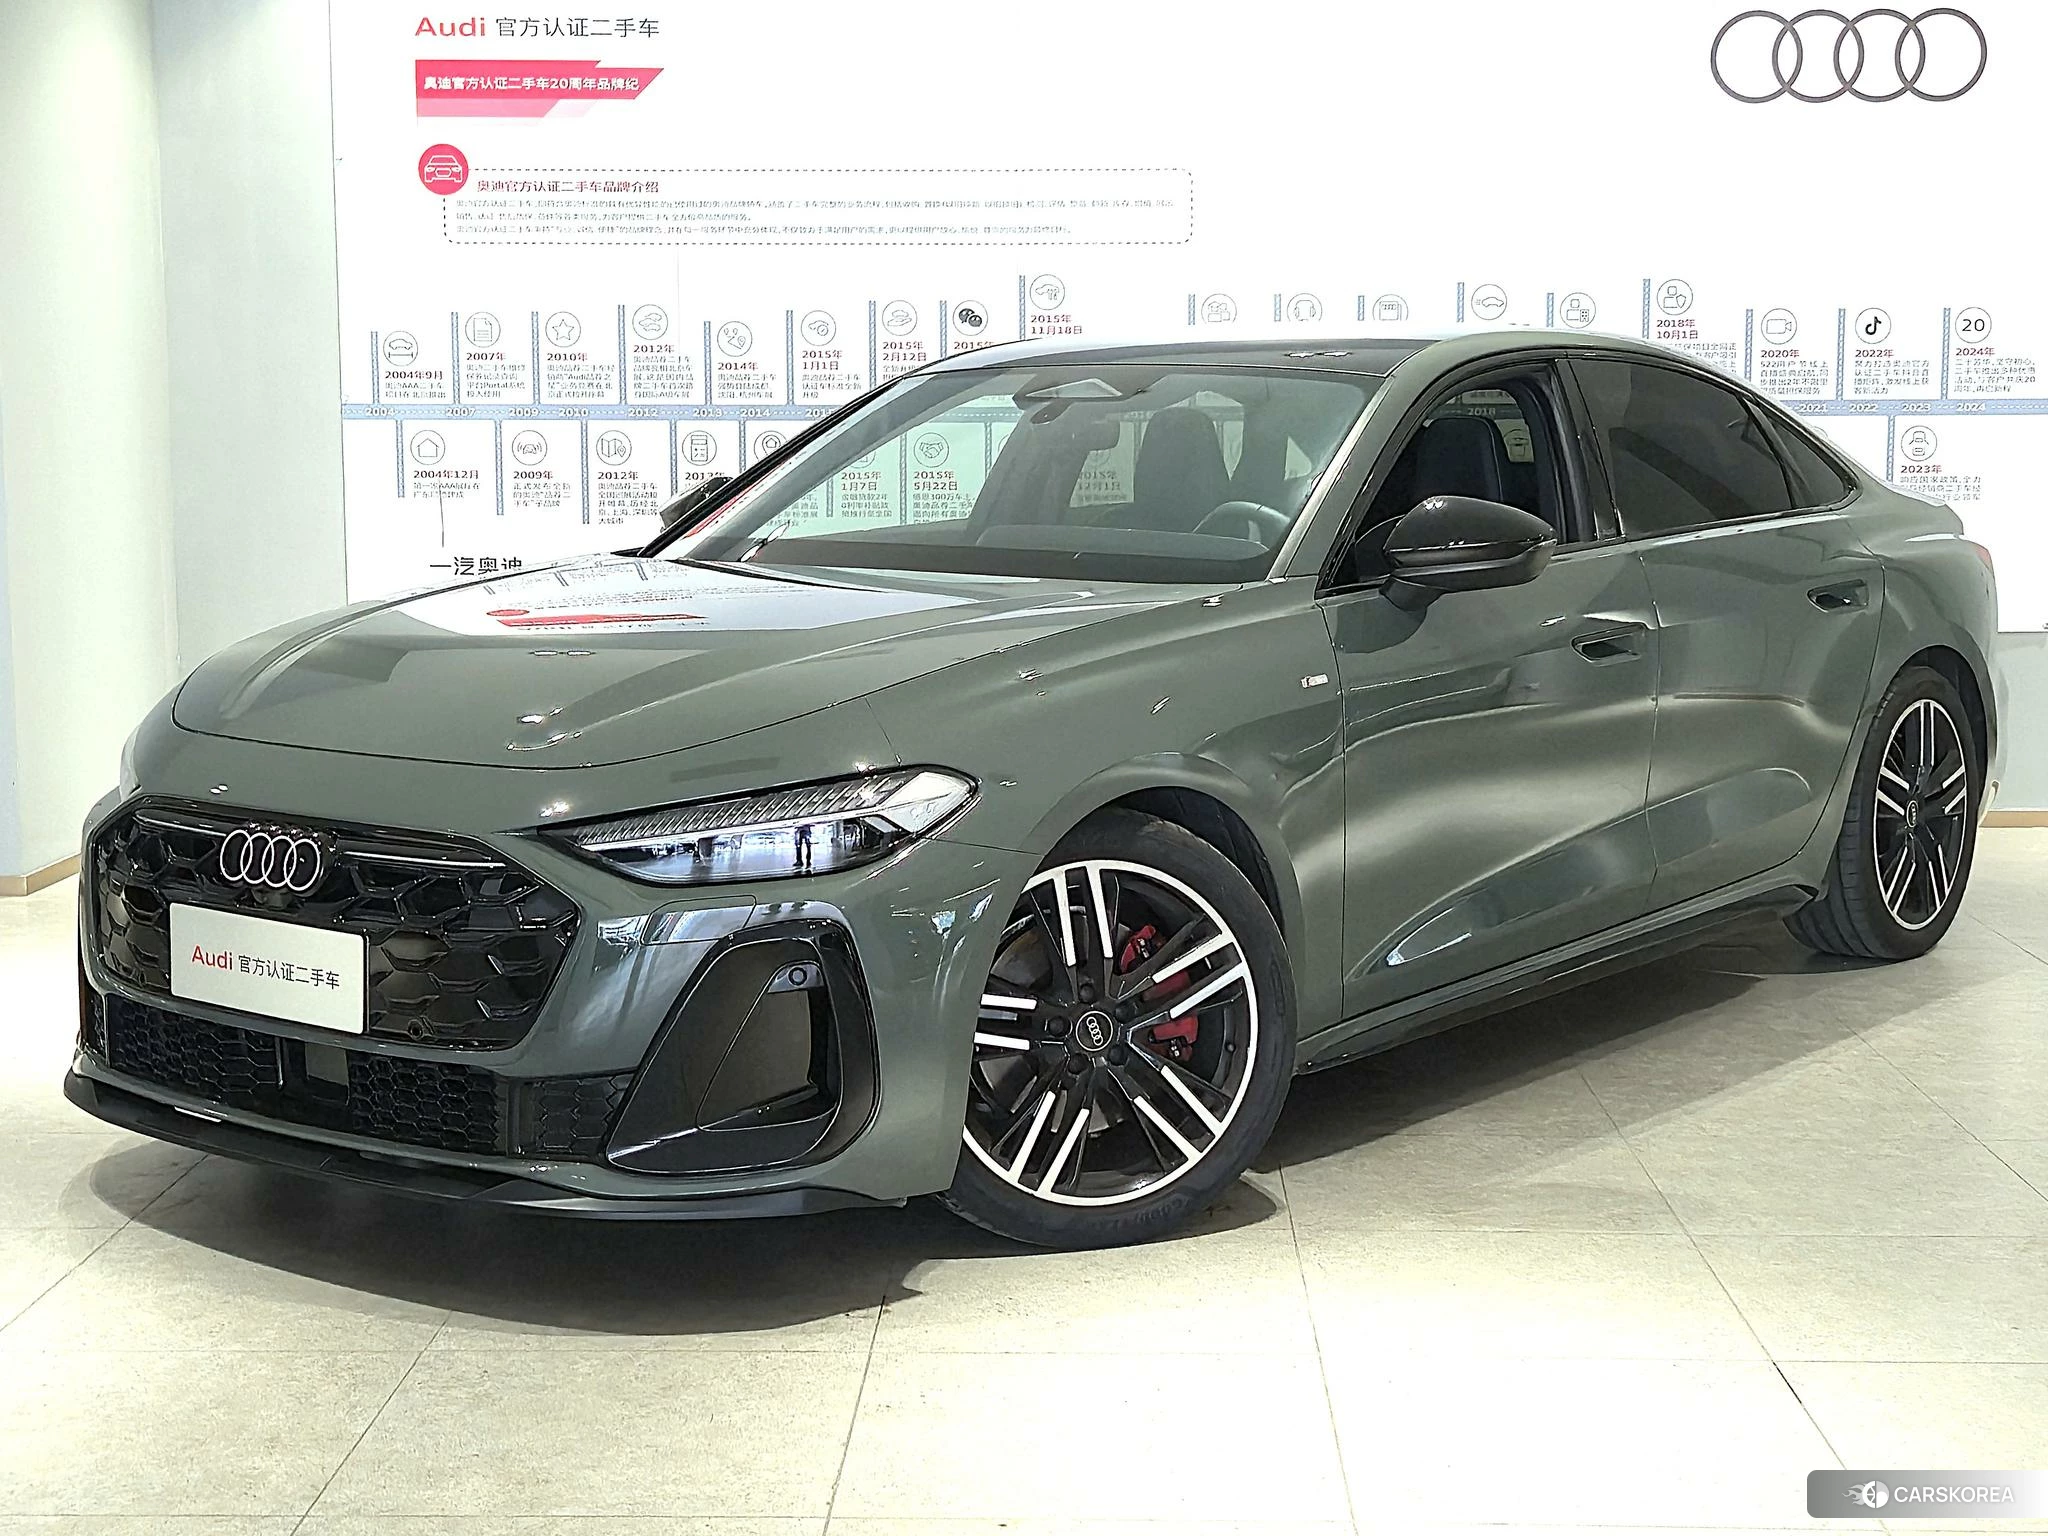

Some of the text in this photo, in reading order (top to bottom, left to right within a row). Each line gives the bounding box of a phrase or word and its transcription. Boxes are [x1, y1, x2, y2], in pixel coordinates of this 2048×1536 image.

[415, 16, 660, 38] Audi 官方认证二手车
[423, 76, 640, 92] 奥迪官方认证二手车20周年品牌纪
[477, 180, 660, 194] 奥迪官方认证二手车品牌介绍
[1030, 314, 1072, 324] 2015年
[1656, 319, 1696, 328] 2018年
[1962, 318, 1985, 332] 20
[1030, 326, 1082, 335] 11月18日
[1657, 330, 1698, 340] 10月1日
[634, 344, 674, 353] 2012年
[883, 341, 924, 350] 2015年
[466, 352, 507, 360] 2007年
[802, 350, 842, 359] 2015年
[1760, 349, 1800, 358] 2020年
[1855, 349, 1894, 358] 2022年
[1956, 347, 1995, 356] 2024年
[547, 352, 588, 362] 2010年
[883, 352, 926, 362] 2月12日
[718, 362, 758, 371] 2014年
[803, 361, 839, 370] 1月1日
[385, 371, 443, 380] 2004年9月
[1799, 403, 1828, 412] 2021
[1850, 403, 1878, 412] 2022
[1902, 403, 1932, 412] 2023
[1956, 402, 1986, 412] 2024
[366, 408, 394, 417] 2004
[447, 408, 476, 417] 2007
[509, 408, 538, 417] 2009
[559, 408, 588, 417] 2010
[629, 408, 658, 417] 2012
[693, 409, 722, 417] 2013
[742, 409, 770, 417] 2014
[1901, 465, 1942, 474] 2023年
[414, 470, 479, 479] 2004年12月
[513, 471, 554, 480] 2009年
[598, 471, 638, 480] 2012年
[841, 472, 881, 480] 2015年
[913, 471, 954, 480] 2015年
[841, 482, 877, 491] 1月7日
[914, 481, 958, 491] 5月22日
[430, 557, 522, 576] 一汽奥迪
[192, 944, 340, 990] Audi 官方认证二手车
